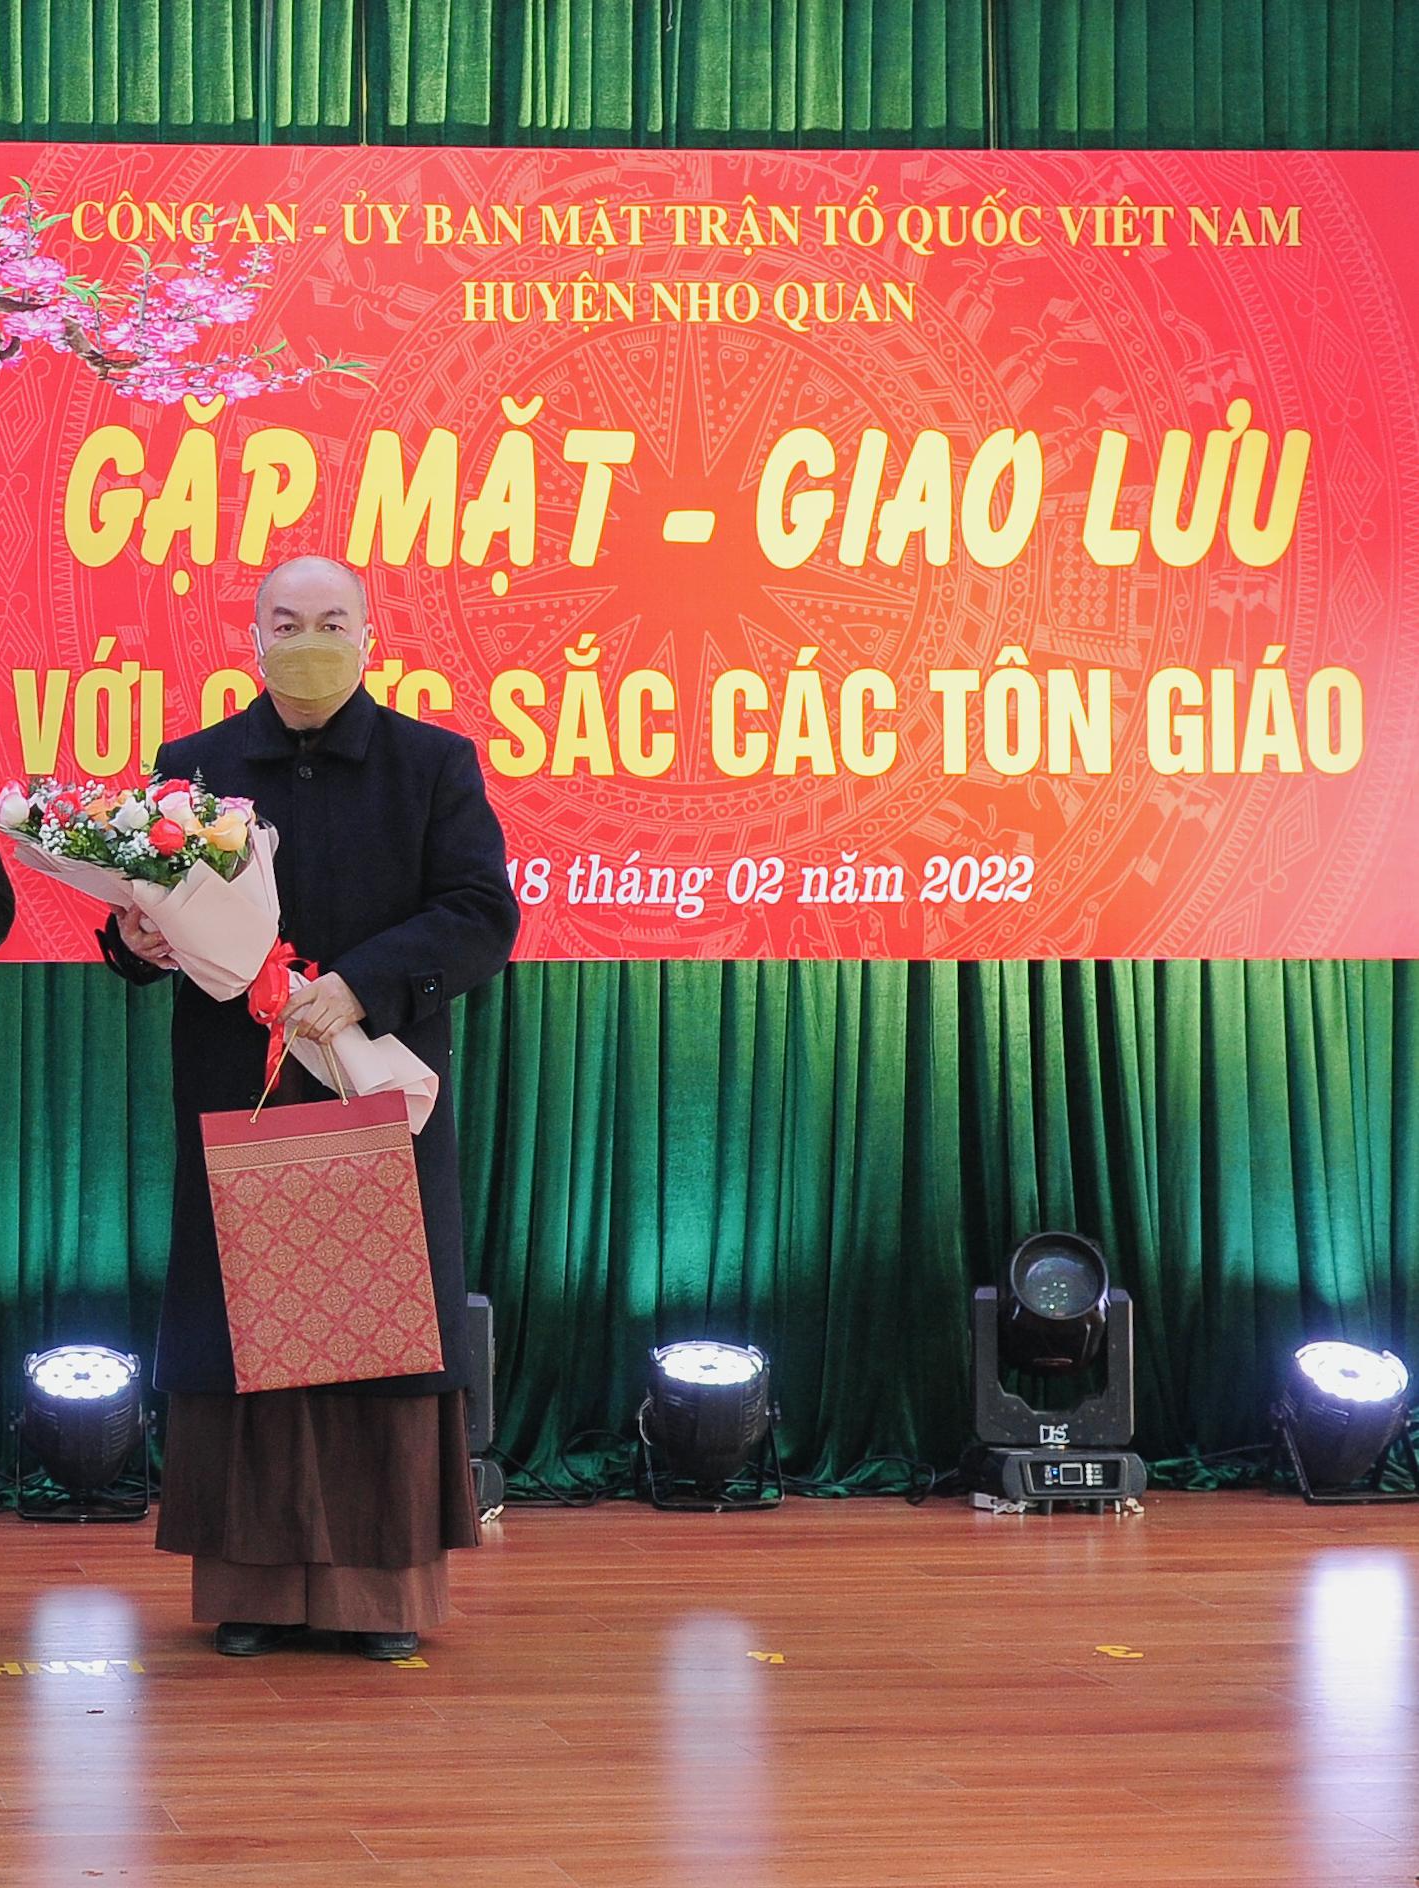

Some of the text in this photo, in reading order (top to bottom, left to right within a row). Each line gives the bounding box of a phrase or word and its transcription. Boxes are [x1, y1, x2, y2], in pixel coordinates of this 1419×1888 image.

[70, 184, 1302, 258] CÔNG AN - ỦY BAN MẶT TRẬN TỔ QUỐC VIỆT NAM
[460, 269, 917, 334] HUYỆN NHO QUAN
[64, 393, 1312, 598] GẶP MẶT - GIAO LƯU
[11, 635, 164, 777] VỚI
[488, 632, 676, 778] SẮC
[711, 645, 898, 777] CÁC
[928, 645, 1112, 776] TÔN
[1146, 643, 1364, 776] GIÁO
[506, 850, 1035, 919] 18 tháng 02 năm 2022
